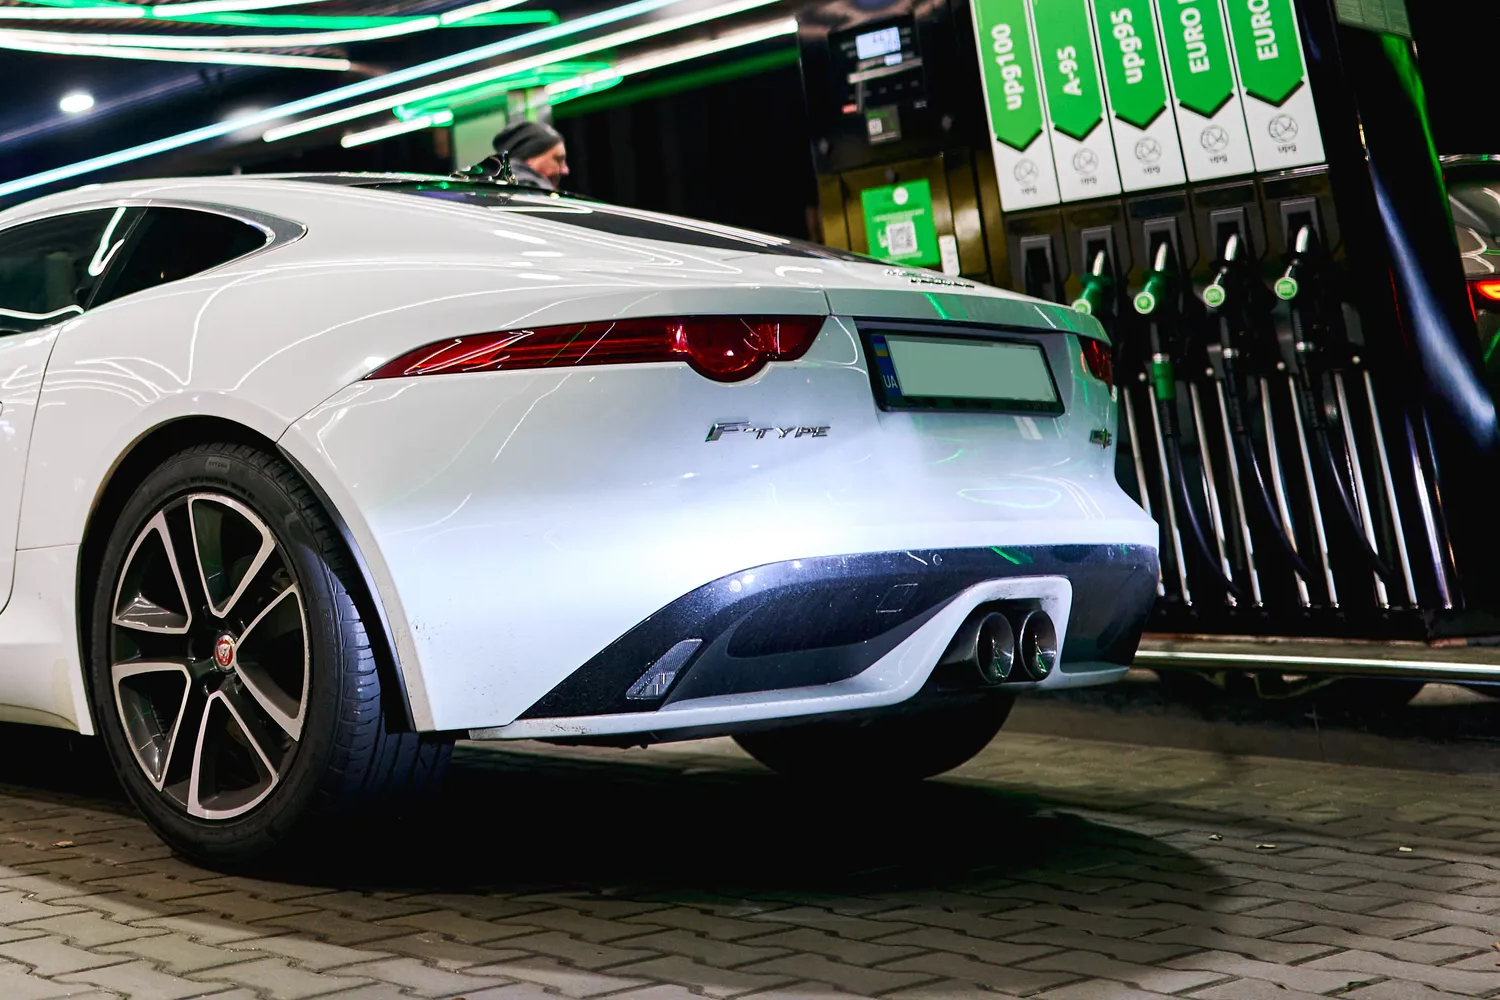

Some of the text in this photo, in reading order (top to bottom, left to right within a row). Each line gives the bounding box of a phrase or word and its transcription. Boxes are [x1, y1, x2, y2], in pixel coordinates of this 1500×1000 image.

[991, 23, 1025, 111] upg100
[1110, 8, 1145, 85] upg95
[1180, 7, 1210, 74] EURO
[1056, 46, 1082, 96] A-95
[883, 374, 899, 389] UA
[705, 421, 832, 442] F-TYPE
